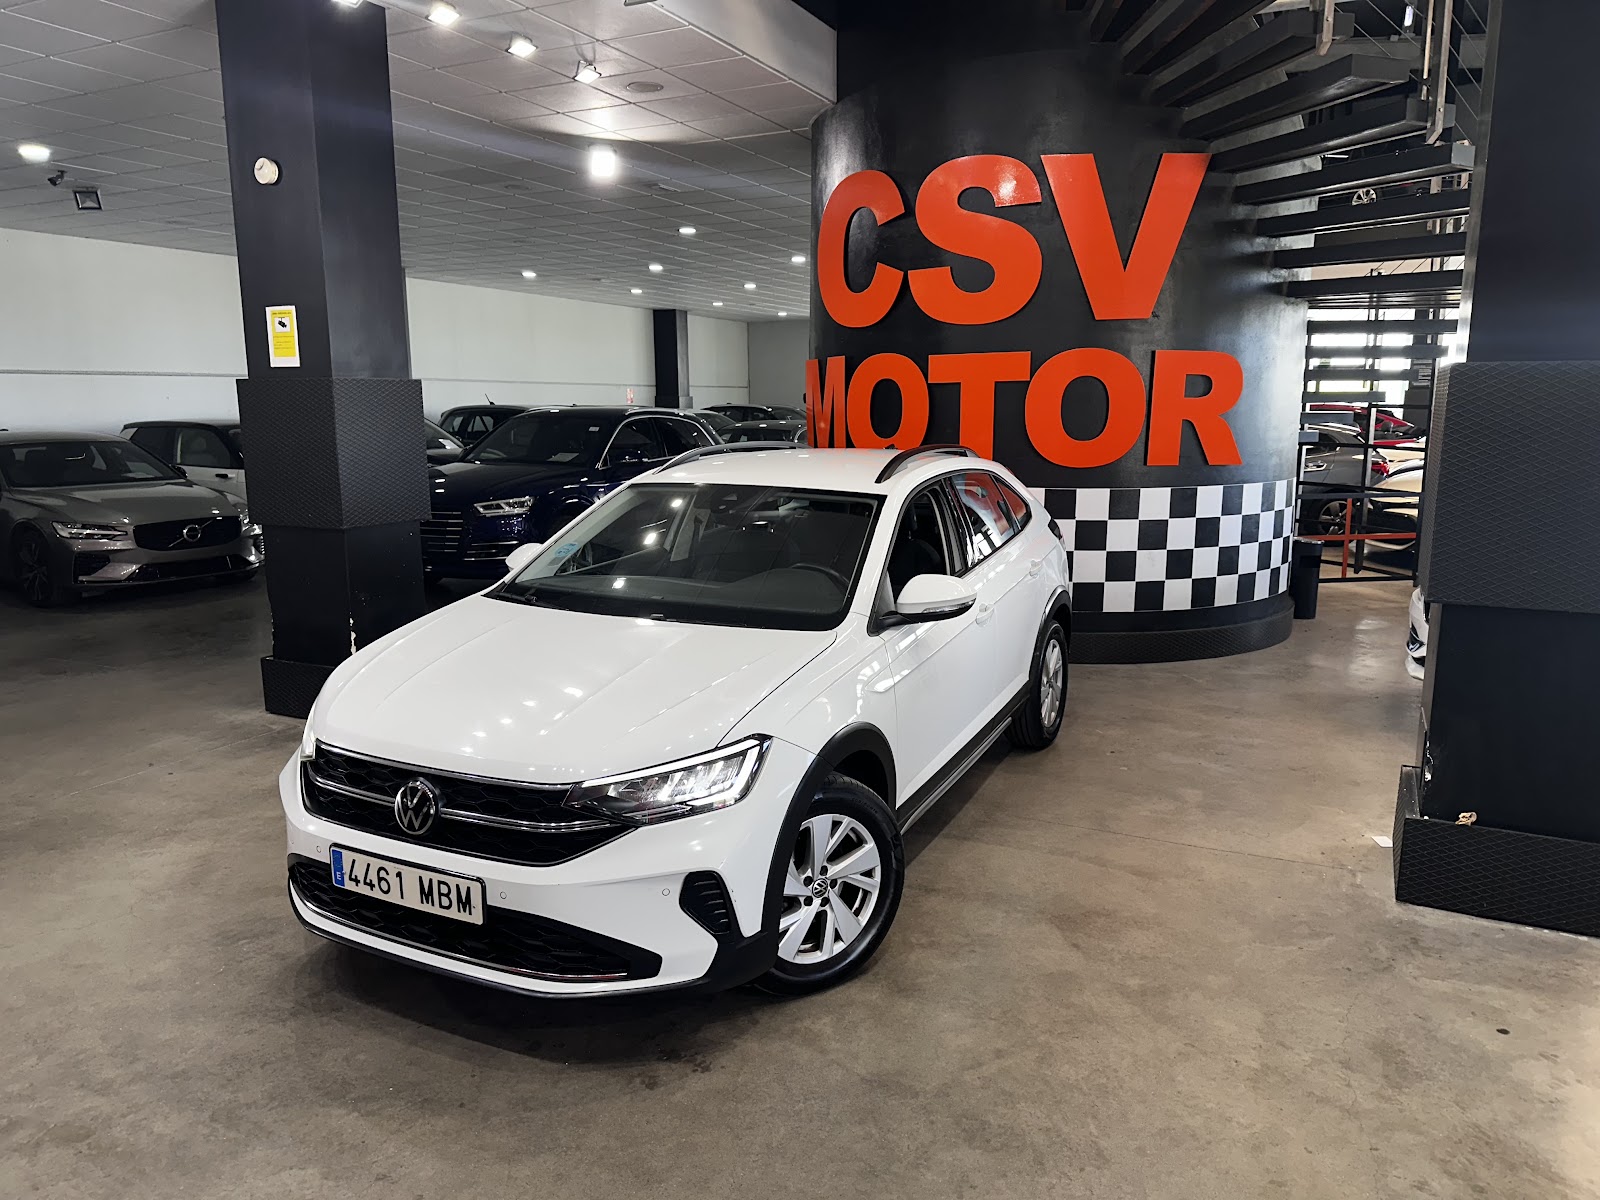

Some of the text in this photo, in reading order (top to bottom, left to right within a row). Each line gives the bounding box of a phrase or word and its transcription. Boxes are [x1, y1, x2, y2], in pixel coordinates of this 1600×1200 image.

[817, 152, 1212, 328] CSV
[805, 347, 1244, 468] MOTOR
[336, 871, 343, 881] E
[348, 858, 473, 916] 4461 MBM
